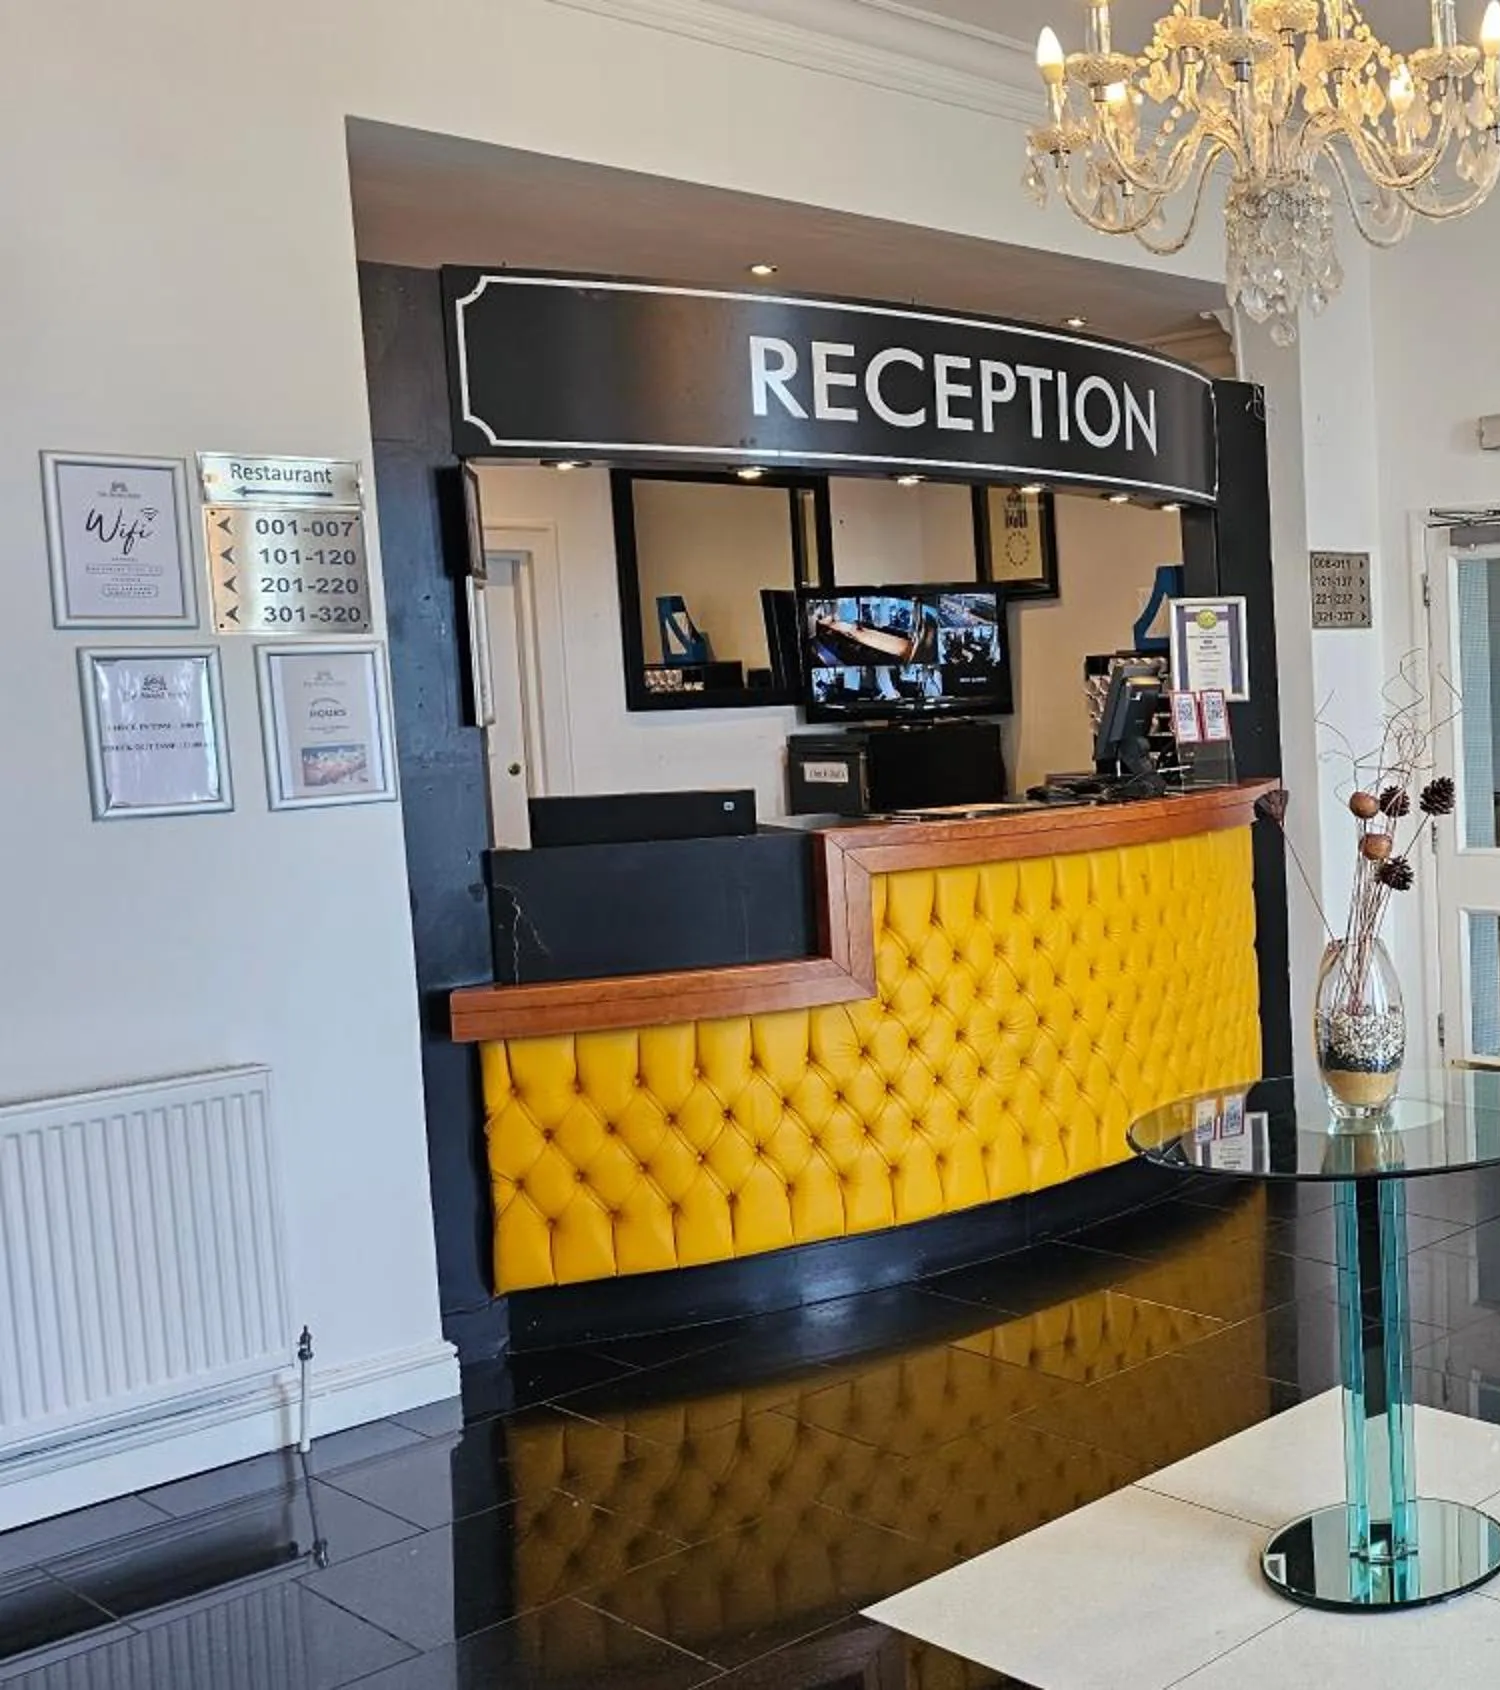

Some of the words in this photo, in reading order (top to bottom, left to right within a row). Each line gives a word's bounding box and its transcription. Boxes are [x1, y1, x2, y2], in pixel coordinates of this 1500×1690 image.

[749, 335, 1158, 457] RECEPTION
[230, 463, 333, 484] Restaurant
[85, 507, 154, 555] Wifi
[255, 519, 354, 537] 001-007
[259, 548, 357, 565] 101-120
[261, 577, 359, 594] 201-220
[264, 606, 361, 623] 301-320
